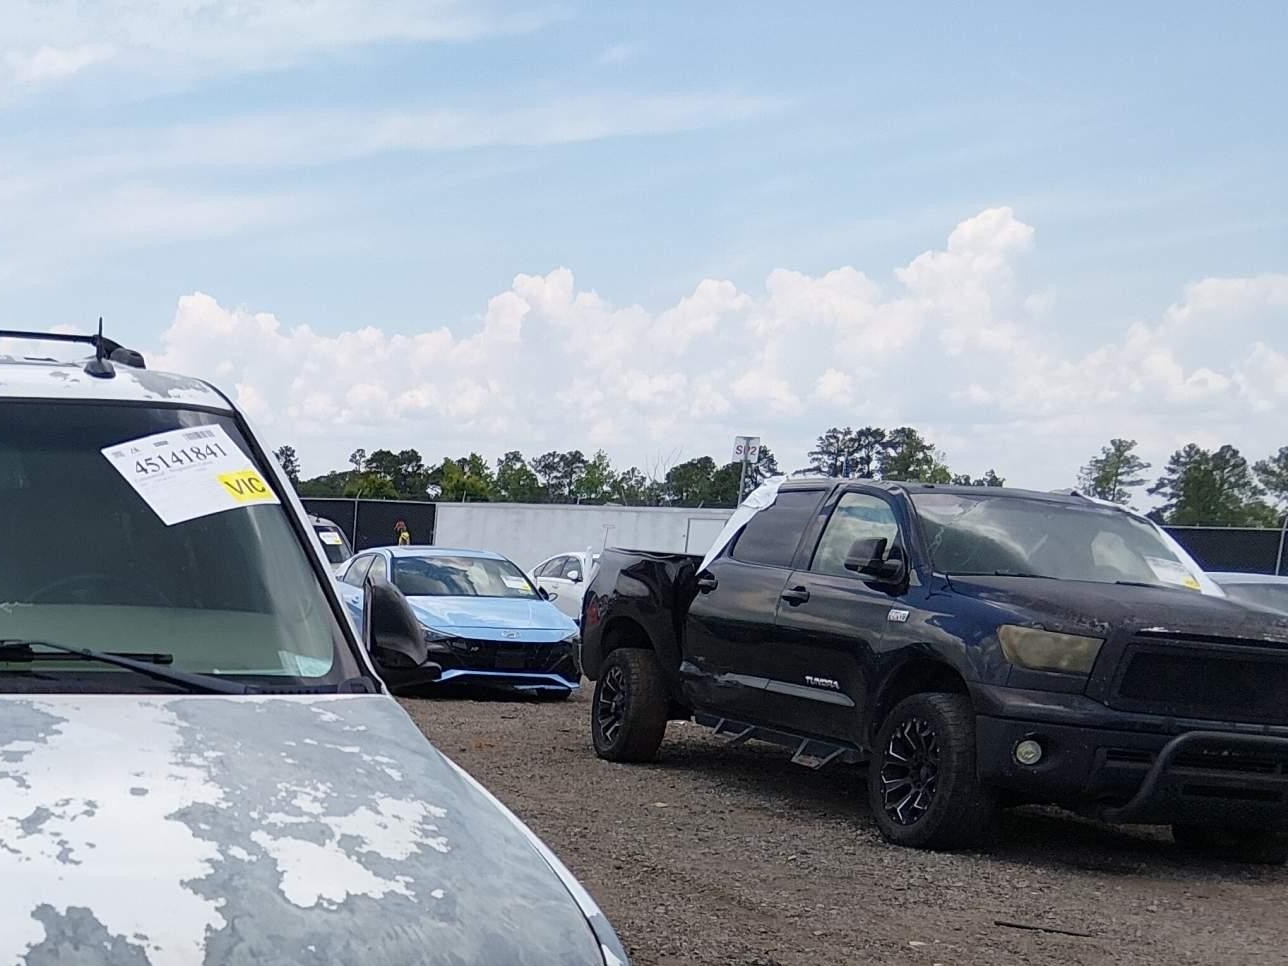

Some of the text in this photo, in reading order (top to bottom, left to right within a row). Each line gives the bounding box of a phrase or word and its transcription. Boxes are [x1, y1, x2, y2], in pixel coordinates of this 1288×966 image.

[135, 443, 227, 475] 45141841
[224, 477, 266, 496] VIC
[805, 675, 840, 690] TUNDRA
